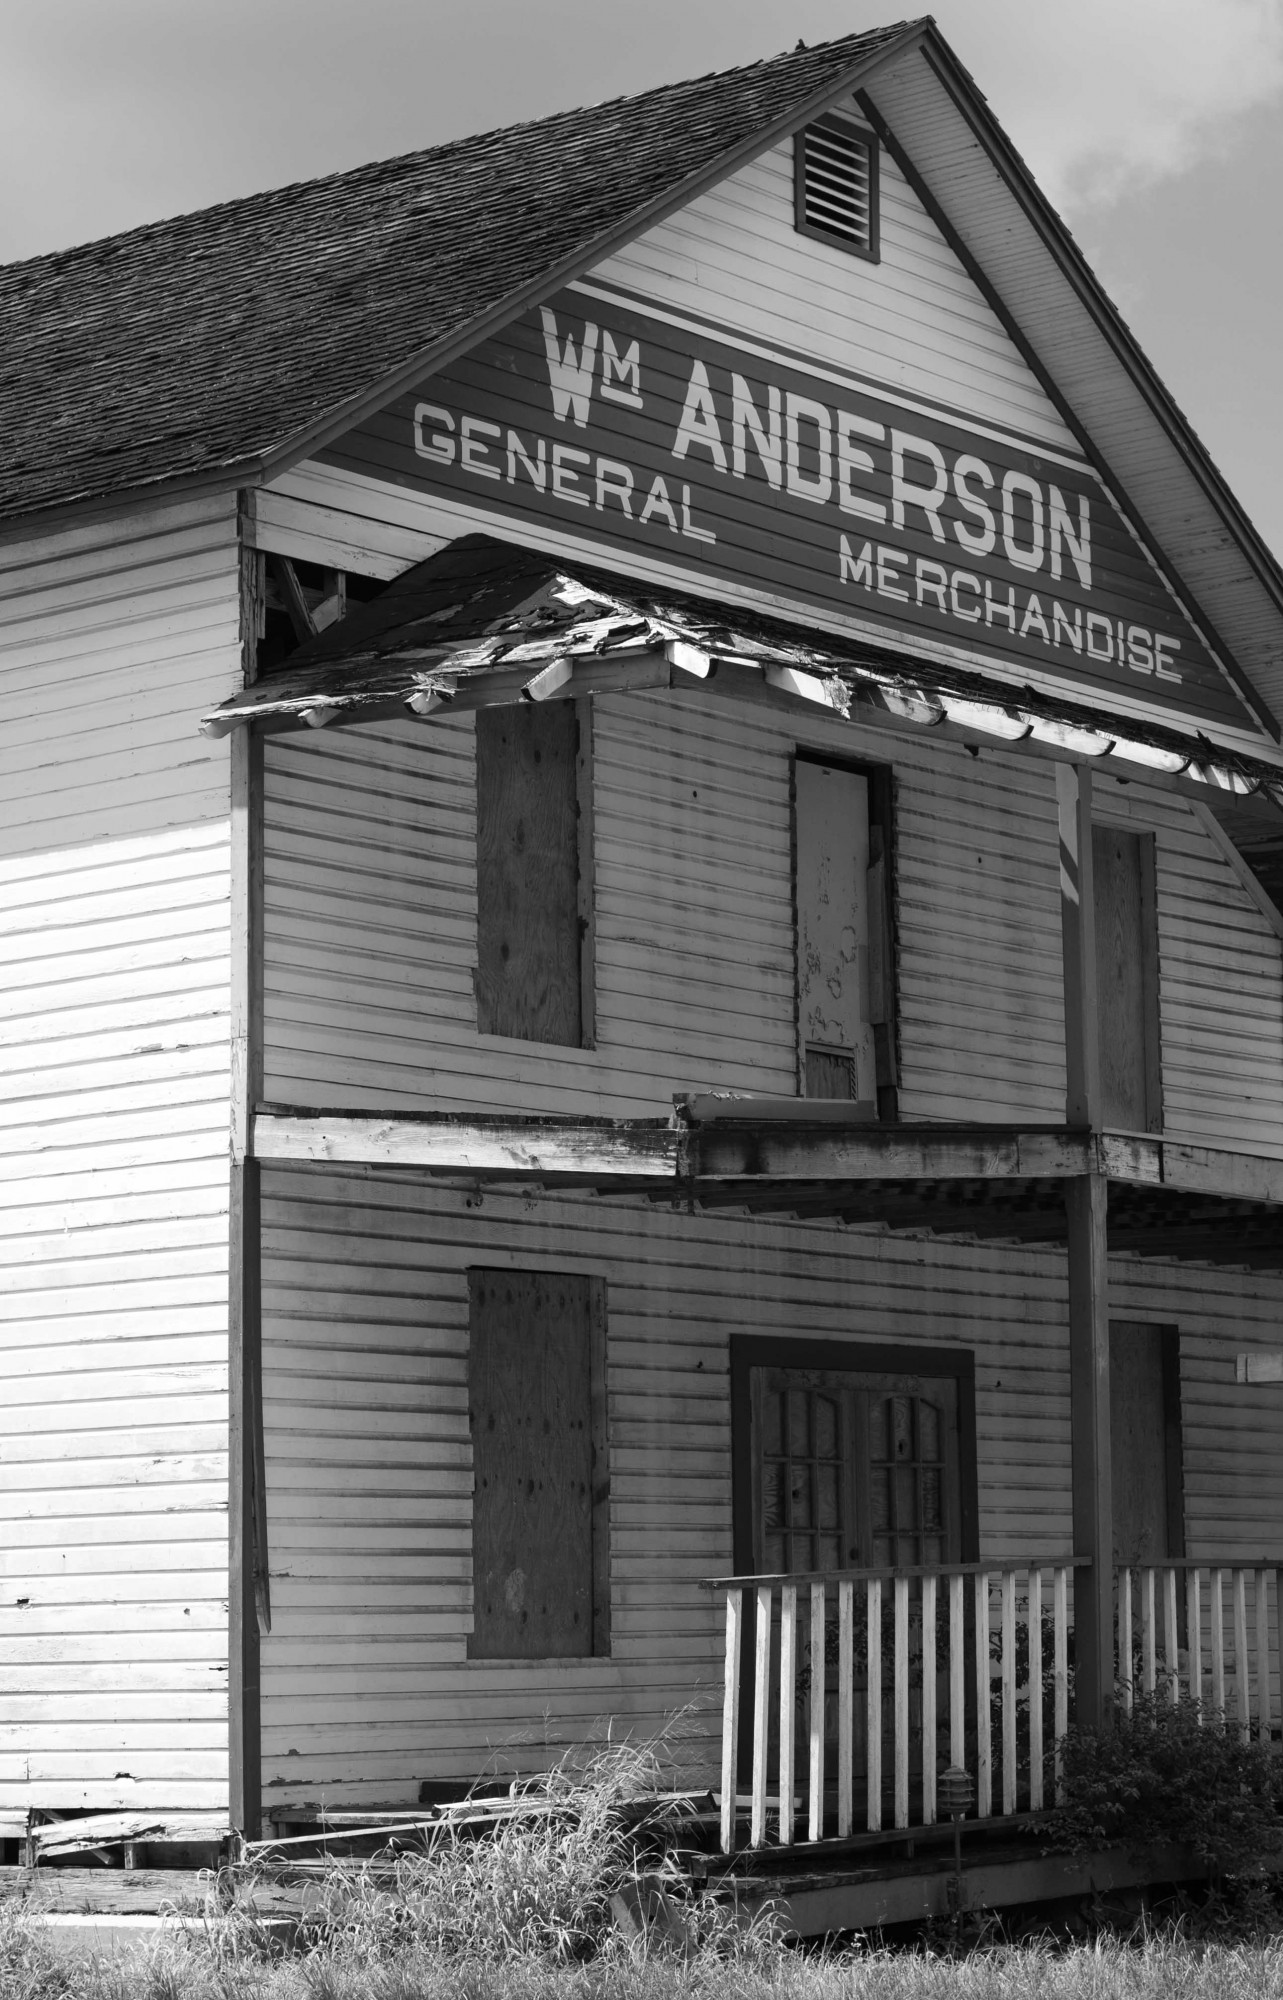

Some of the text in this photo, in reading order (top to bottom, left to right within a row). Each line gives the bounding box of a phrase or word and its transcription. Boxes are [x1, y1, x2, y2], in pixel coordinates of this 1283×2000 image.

[413, 402, 1183, 684] GENERAL MERCHANDISE
[671, 359, 1092, 590] ANDERSON
